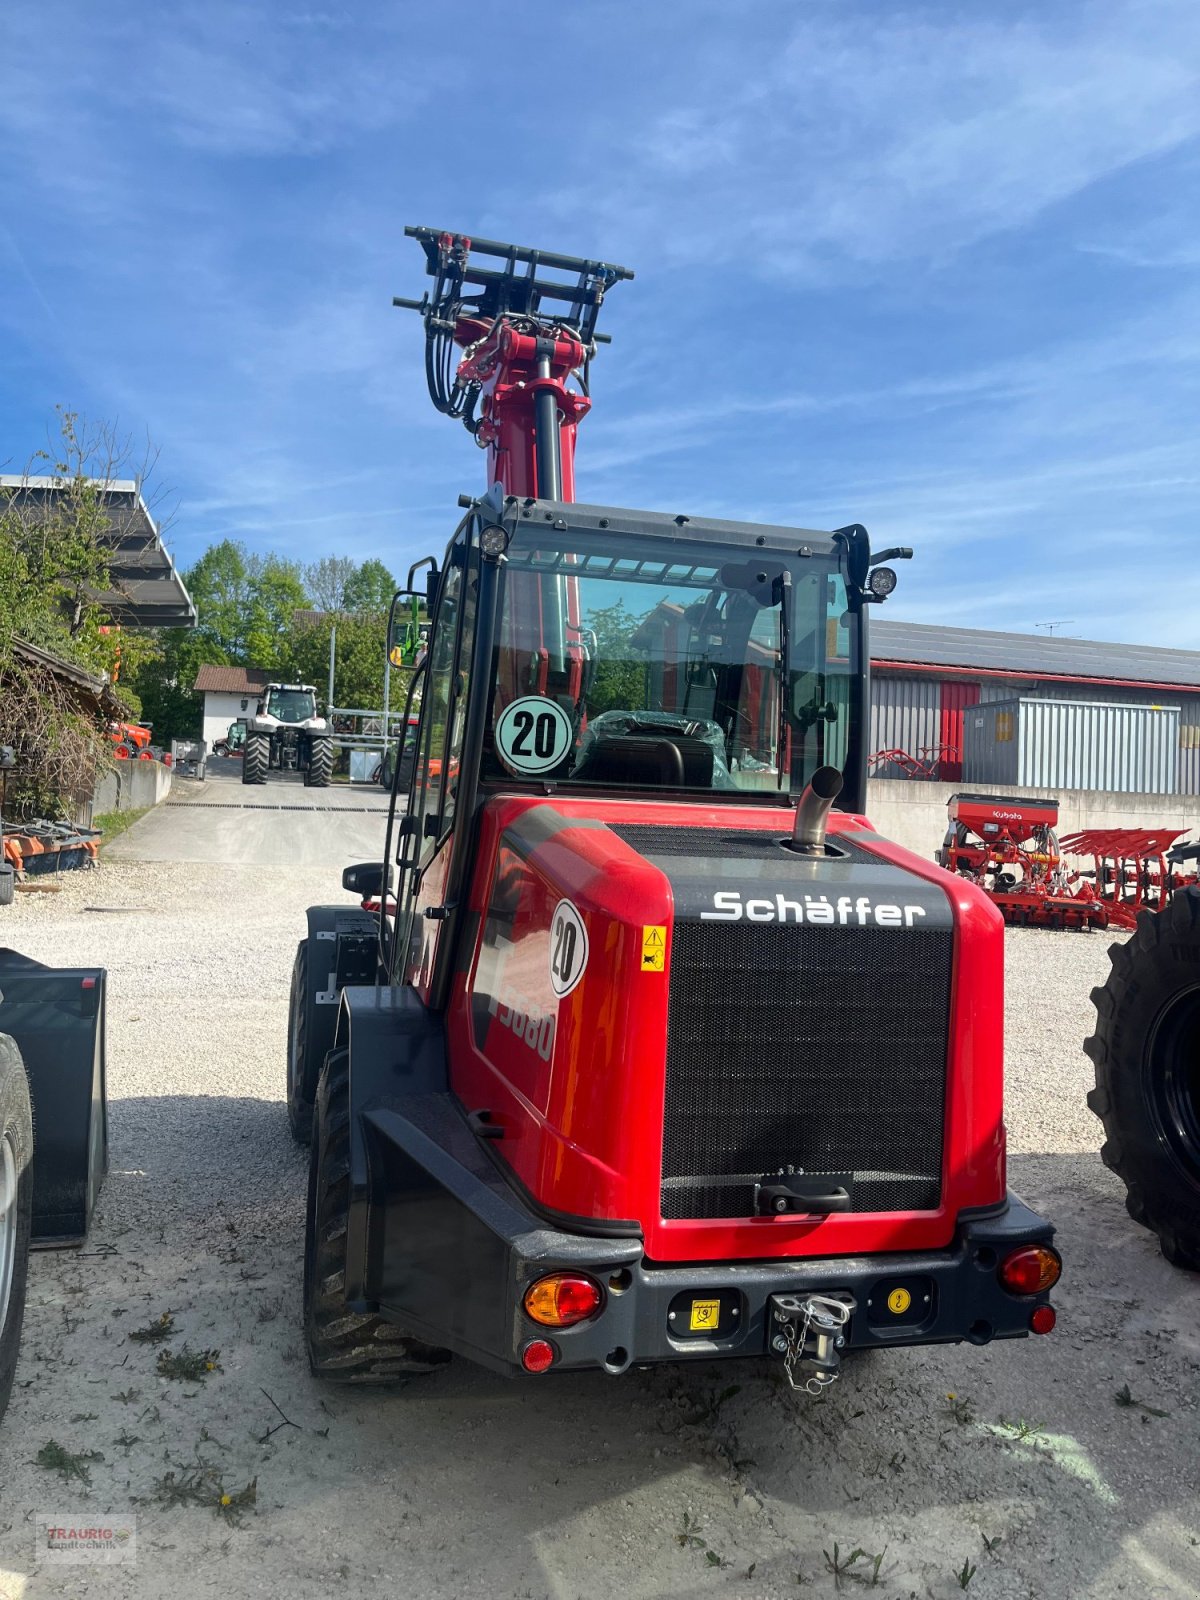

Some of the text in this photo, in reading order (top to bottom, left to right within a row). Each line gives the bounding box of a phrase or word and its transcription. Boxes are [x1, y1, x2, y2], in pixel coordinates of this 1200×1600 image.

[511, 711, 556, 758] 20
[992, 810, 1023, 820] Kubota
[700, 891, 926, 927] Schäffer
[552, 915, 577, 982] 20
